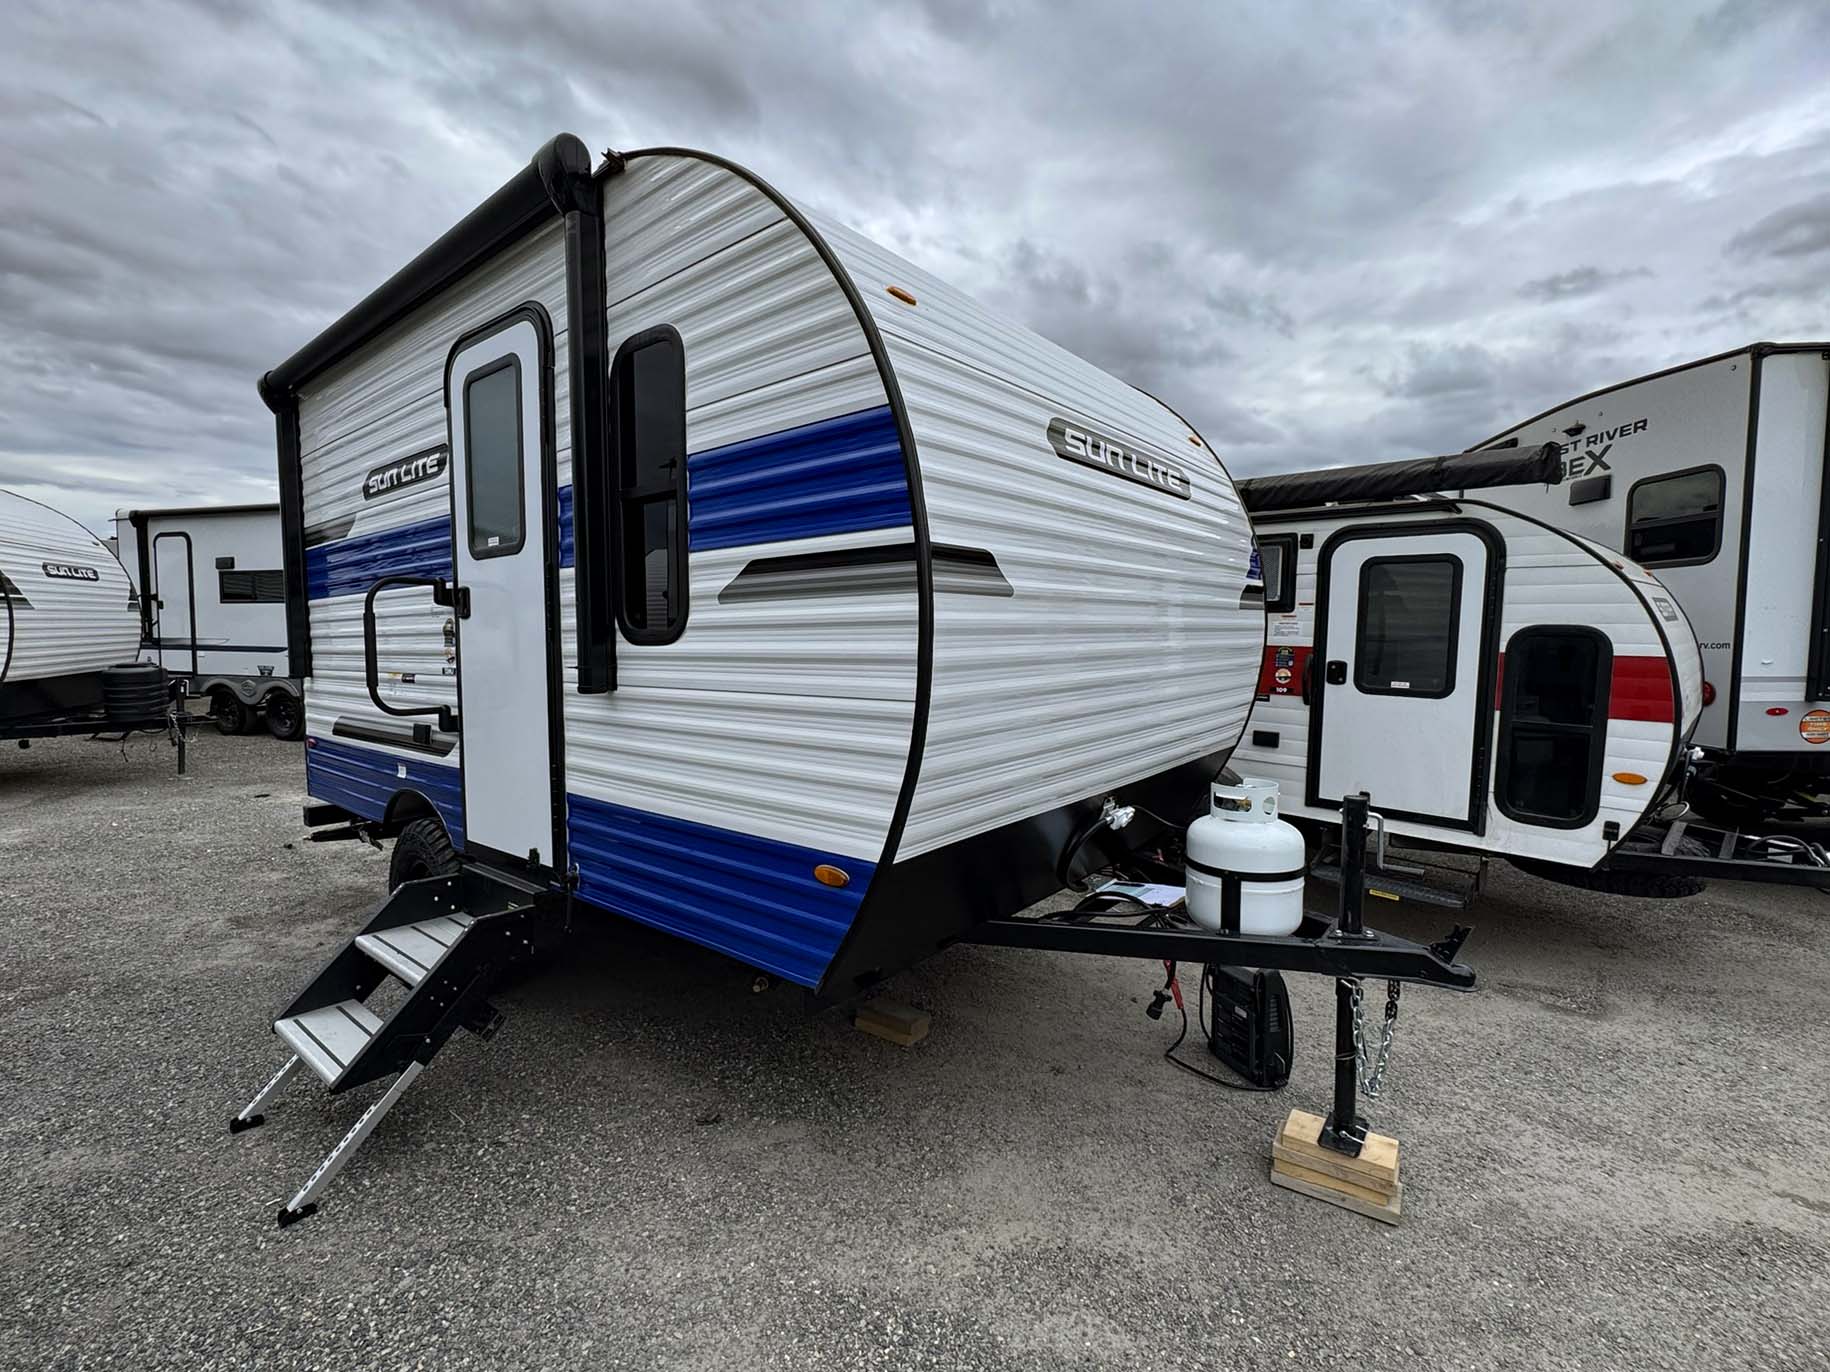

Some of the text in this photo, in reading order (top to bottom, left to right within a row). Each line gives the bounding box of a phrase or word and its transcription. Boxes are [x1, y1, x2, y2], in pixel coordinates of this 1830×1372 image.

[1586, 418, 1648, 447] RIVER
[368, 453, 440, 494] SUN LITE
[1064, 427, 1183, 492] SUN LITE
[1699, 641, 1731, 650] rv.com
